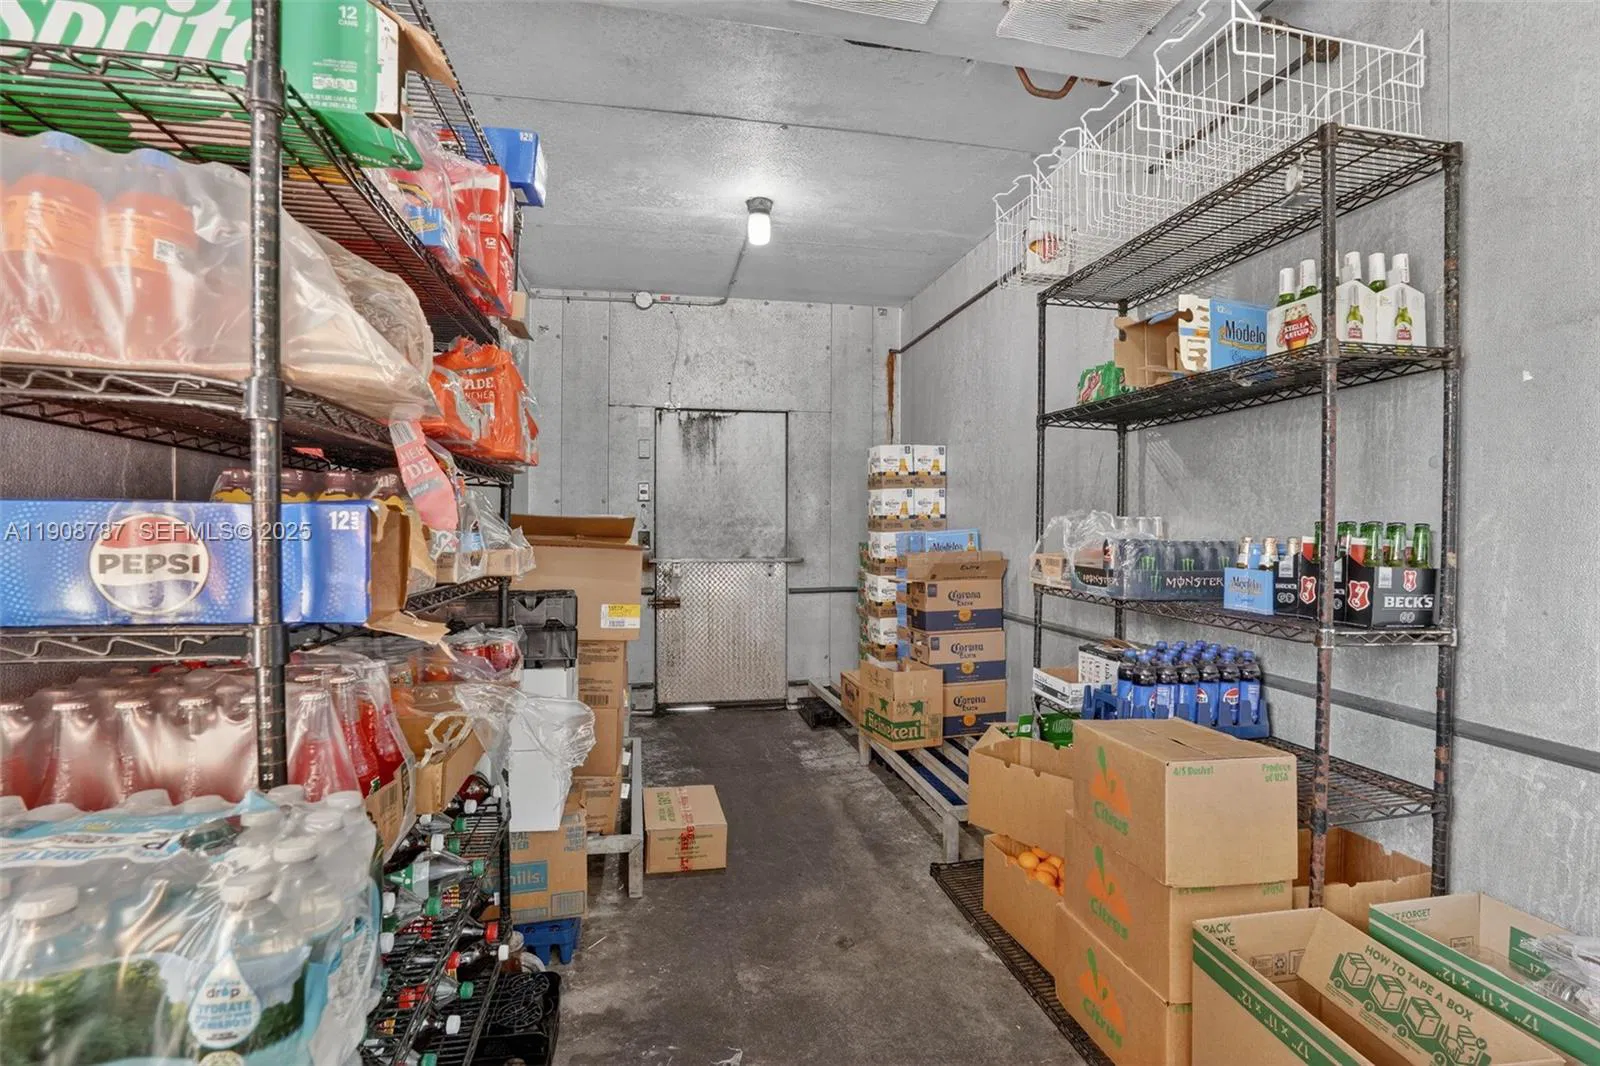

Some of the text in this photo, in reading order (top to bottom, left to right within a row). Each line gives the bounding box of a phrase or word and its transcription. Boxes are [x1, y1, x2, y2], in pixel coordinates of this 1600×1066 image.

[338, 5, 358, 20] 12
[1225, 319, 1267, 344] Modelo
[329, 511, 349, 530] 12
[99, 553, 201, 575] PEPSI
[1165, 576, 1224, 588] MONSTER
[948, 590, 981, 602] Corona
[1384, 594, 1434, 609] BECK'S
[951, 643, 984, 655] Corona
[953, 696, 986, 708] Corona
[1189, 766, 1214, 775] Bushel
[1262, 764, 1291, 773] Produce
[1094, 800, 1130, 836] Citrus
[1089, 896, 1128, 940] Citrus
[1401, 908, 1430, 920] FORGET
[1203, 923, 1231, 937] PACK
[1364, 945, 1474, 1022] HOW TO TAPE A BOX
[1082, 997, 1123, 1049] Citrus
